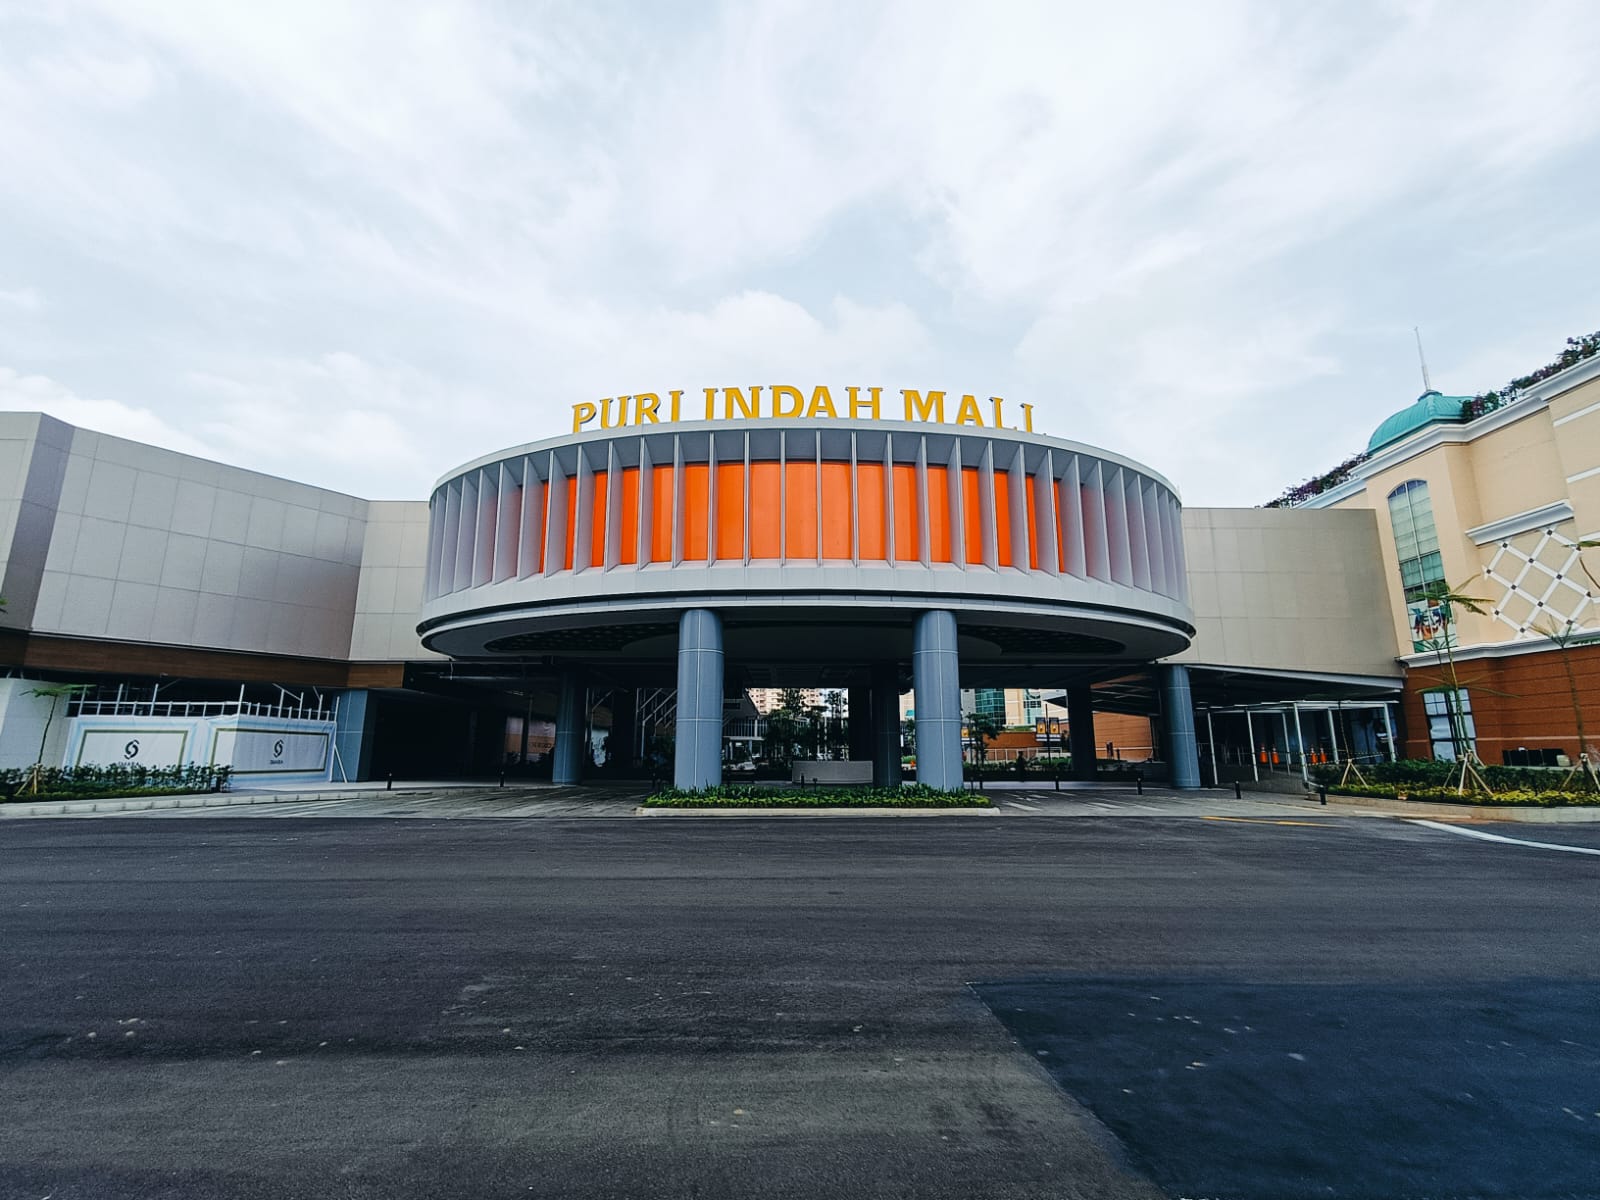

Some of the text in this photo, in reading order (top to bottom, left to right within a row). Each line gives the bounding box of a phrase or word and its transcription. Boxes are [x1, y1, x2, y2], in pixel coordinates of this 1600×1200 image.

[571, 385, 1034, 433] PURI INDAH MALL
